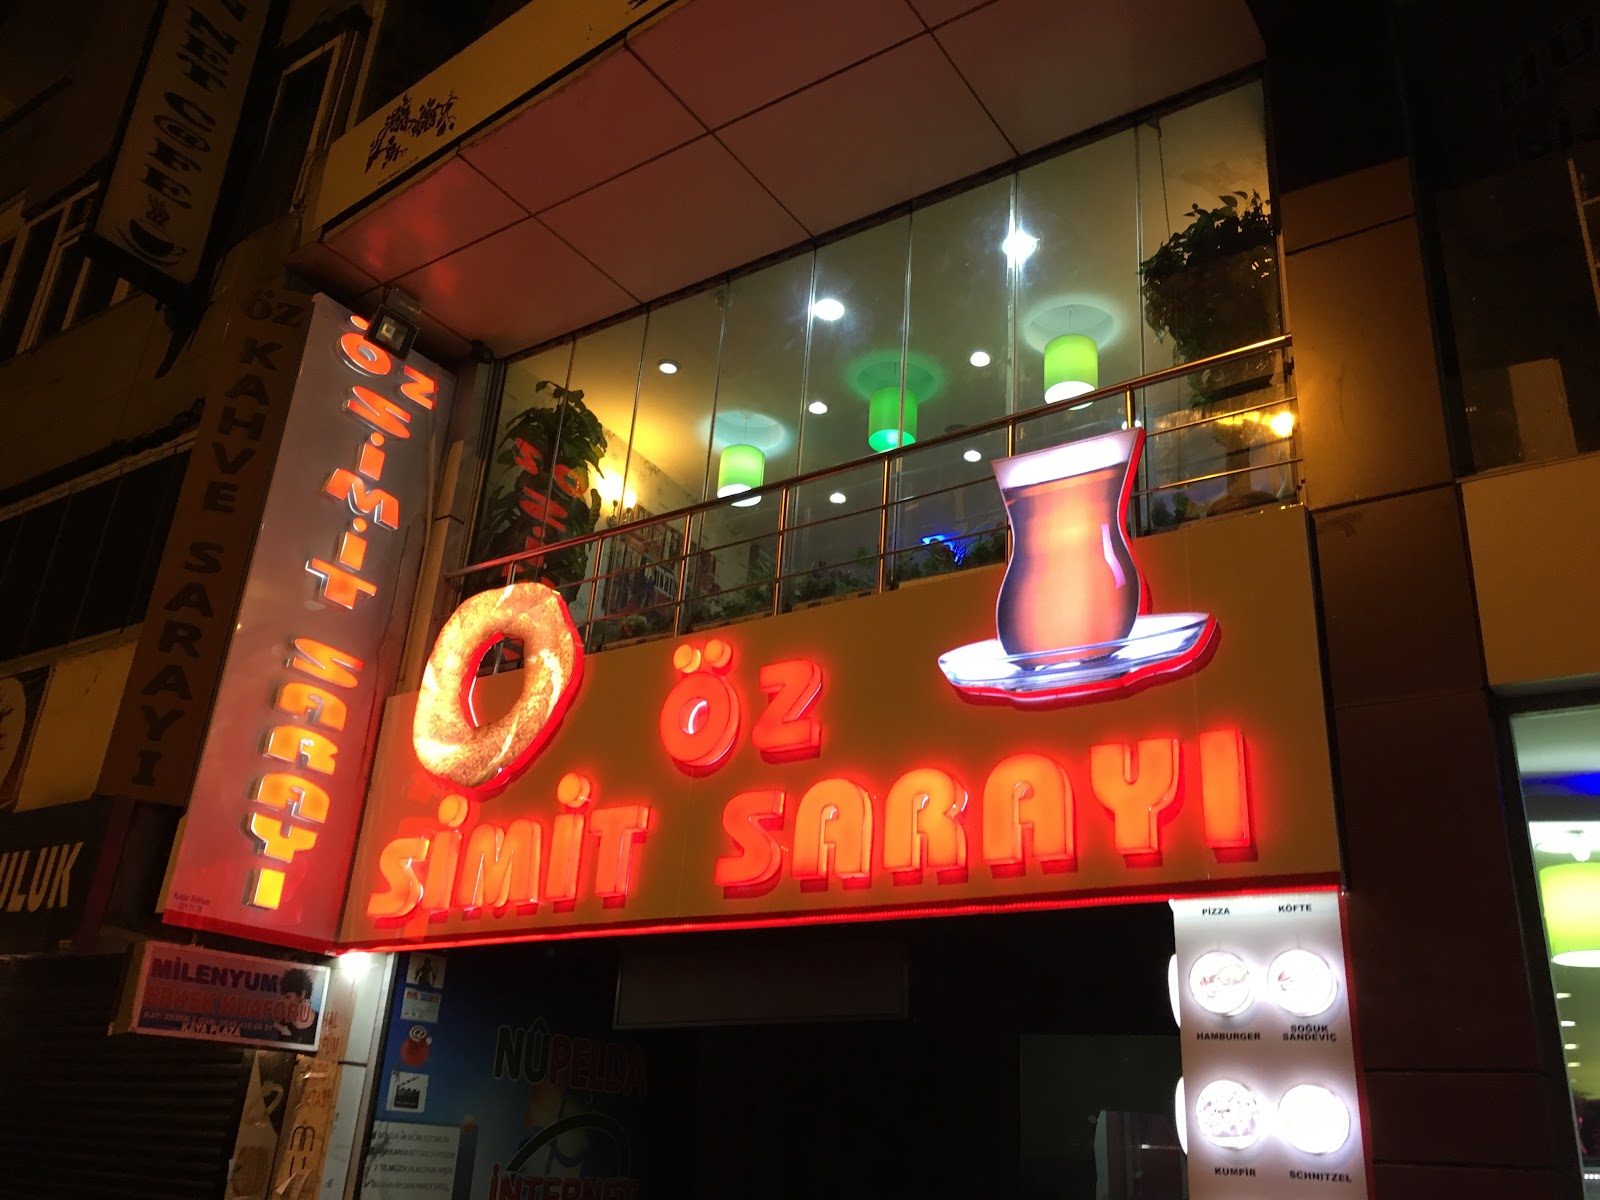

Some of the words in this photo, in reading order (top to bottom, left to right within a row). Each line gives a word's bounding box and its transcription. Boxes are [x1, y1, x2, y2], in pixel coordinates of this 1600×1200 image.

[202, 336, 283, 513] KAHVE
[306, 385, 412, 610] SİMİT
[131, 541, 225, 786] SARAYI
[659, 641, 823, 772] ÖZ
[250, 637, 364, 911] SARAYI
[366, 772, 648, 921] SİMİT
[713, 729, 1253, 892] SARAYI
[1202, 906, 1230, 916] PİZZA
[1278, 904, 1312, 913] KÖFTE
[151, 956, 278, 992] MİLENYUM
[1196, 1032, 1261, 1041] HAMBURGER
[1282, 1032, 1337, 1043] SANDEVİÇ
[1290, 1023, 1329, 1033] SOĞUK
[1213, 1166, 1256, 1178] KUMPİR
[1289, 1170, 1352, 1183] SCHNITZEL
